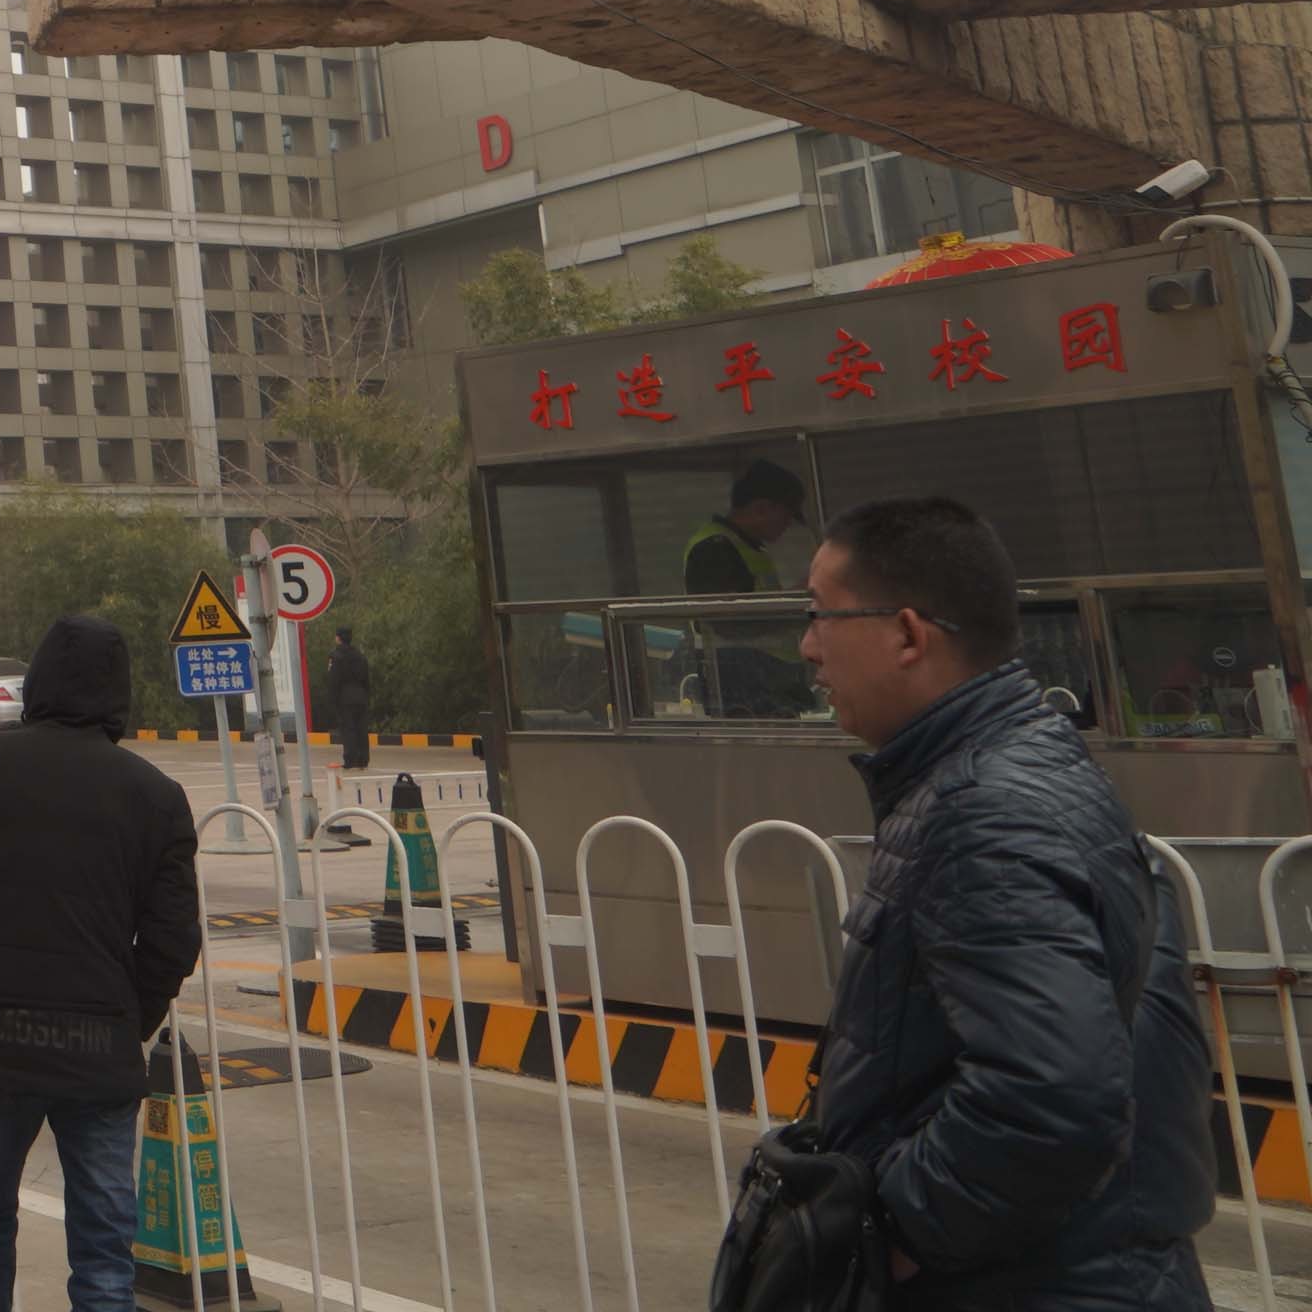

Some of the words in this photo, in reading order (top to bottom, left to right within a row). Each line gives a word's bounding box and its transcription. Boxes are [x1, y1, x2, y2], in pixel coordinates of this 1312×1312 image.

[477, 114, 514, 172] D
[529, 302, 1128, 430] 打造平安校园
[281, 562, 309, 605] 5
[196, 605, 222, 630] 慢
[187, 648, 214, 661] 此处
[189, 661, 243, 677] 严禁停放
[191, 675, 245, 691] 各种车辆
